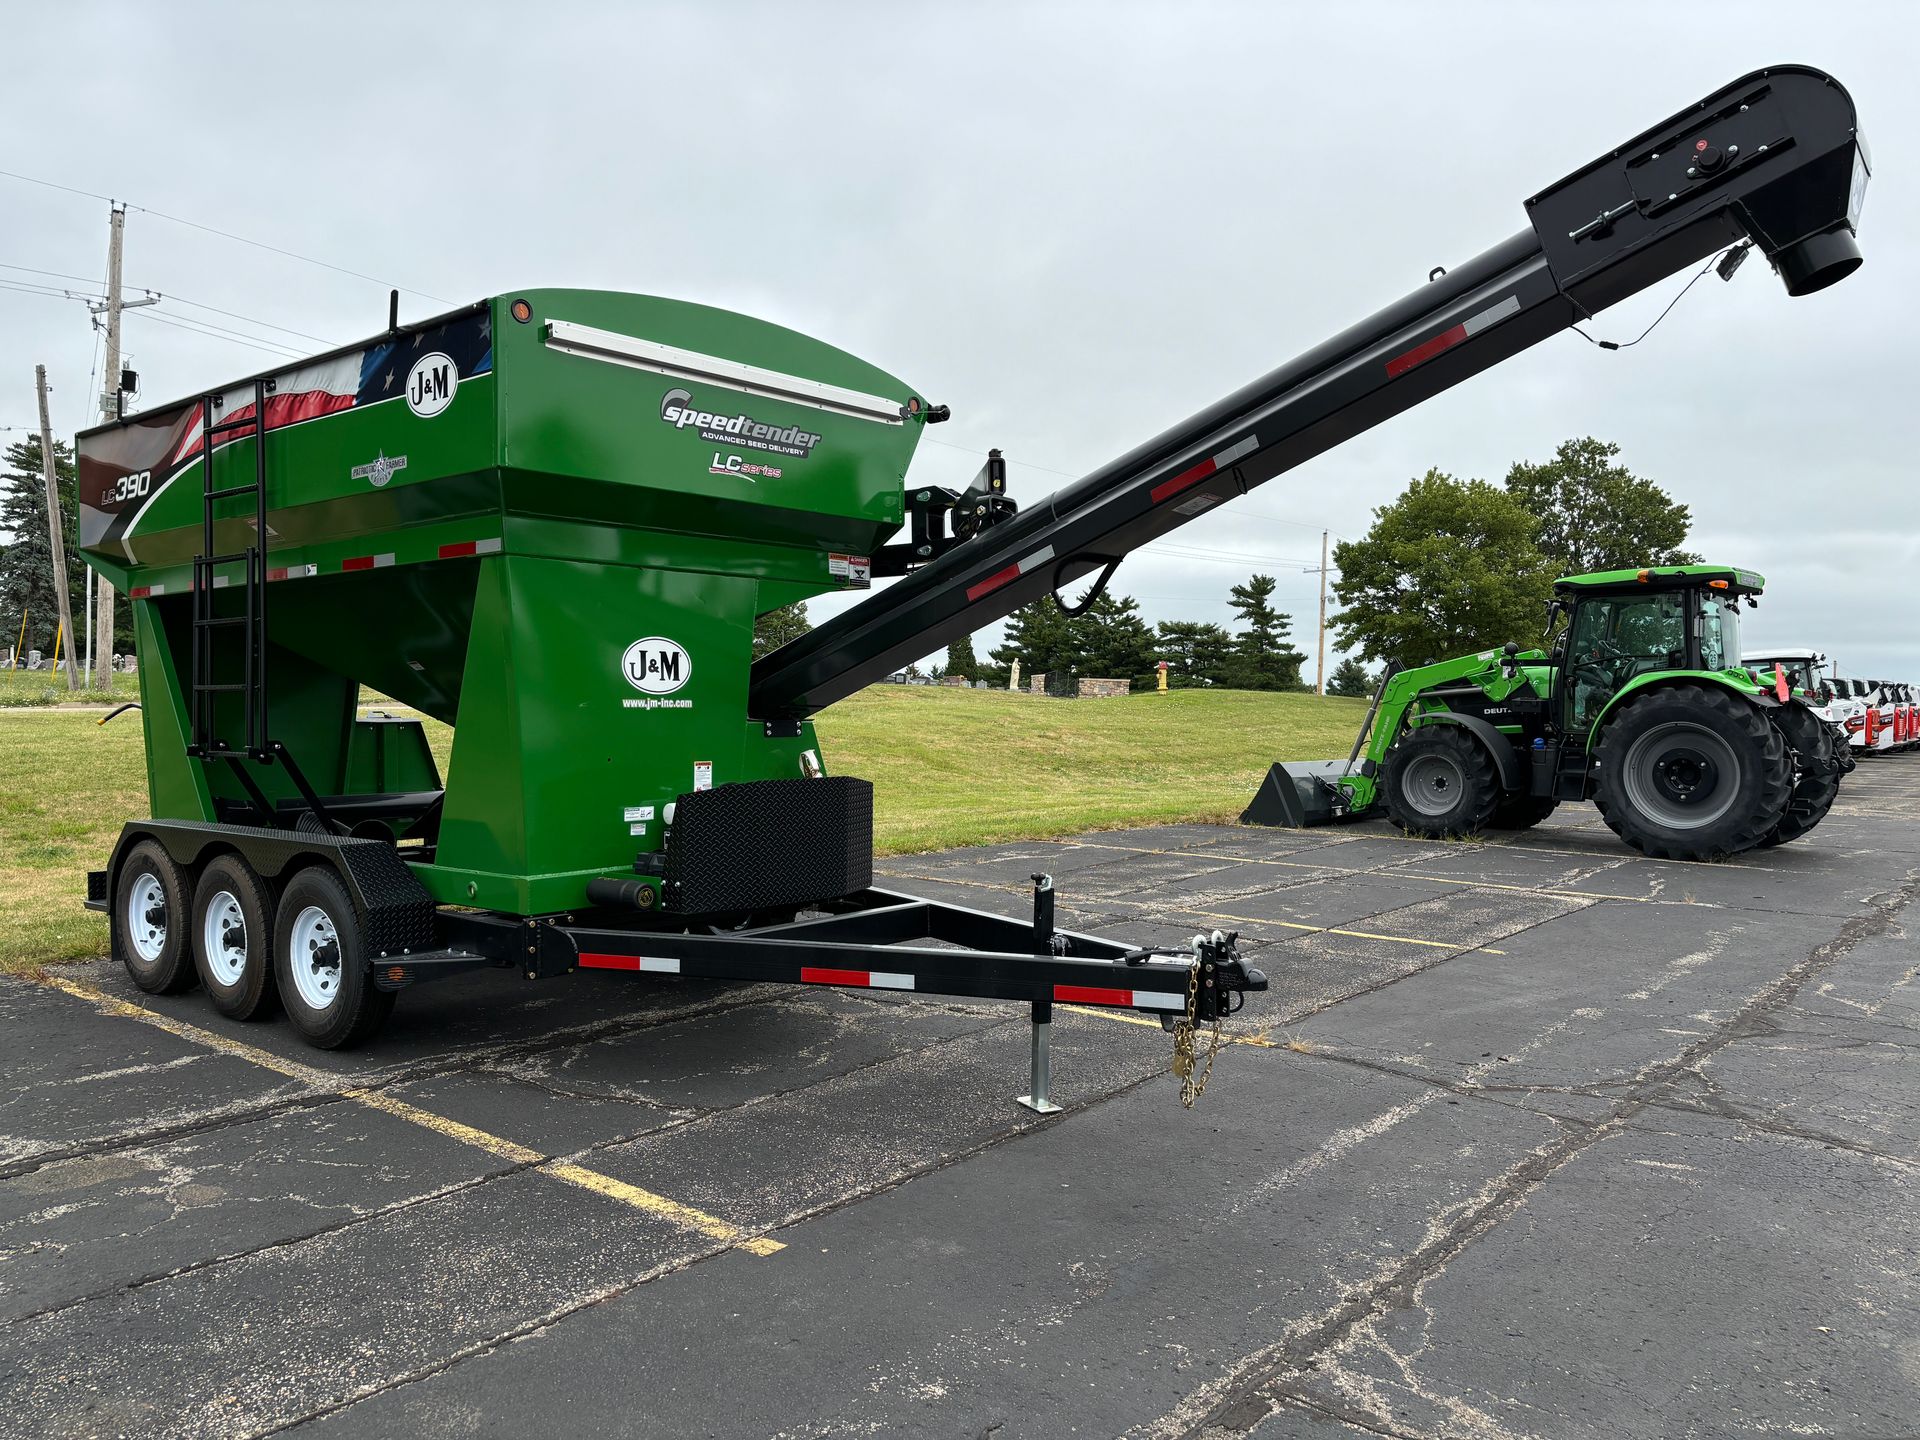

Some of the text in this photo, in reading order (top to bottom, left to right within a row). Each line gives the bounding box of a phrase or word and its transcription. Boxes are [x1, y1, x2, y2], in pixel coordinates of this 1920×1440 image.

[411, 364, 449, 406] J&M
[702, 431, 805, 456] ADVANCED SEED DELIVERY
[629, 650, 681, 681] J&M
[622, 697, 693, 711] www.jm-inc.com
